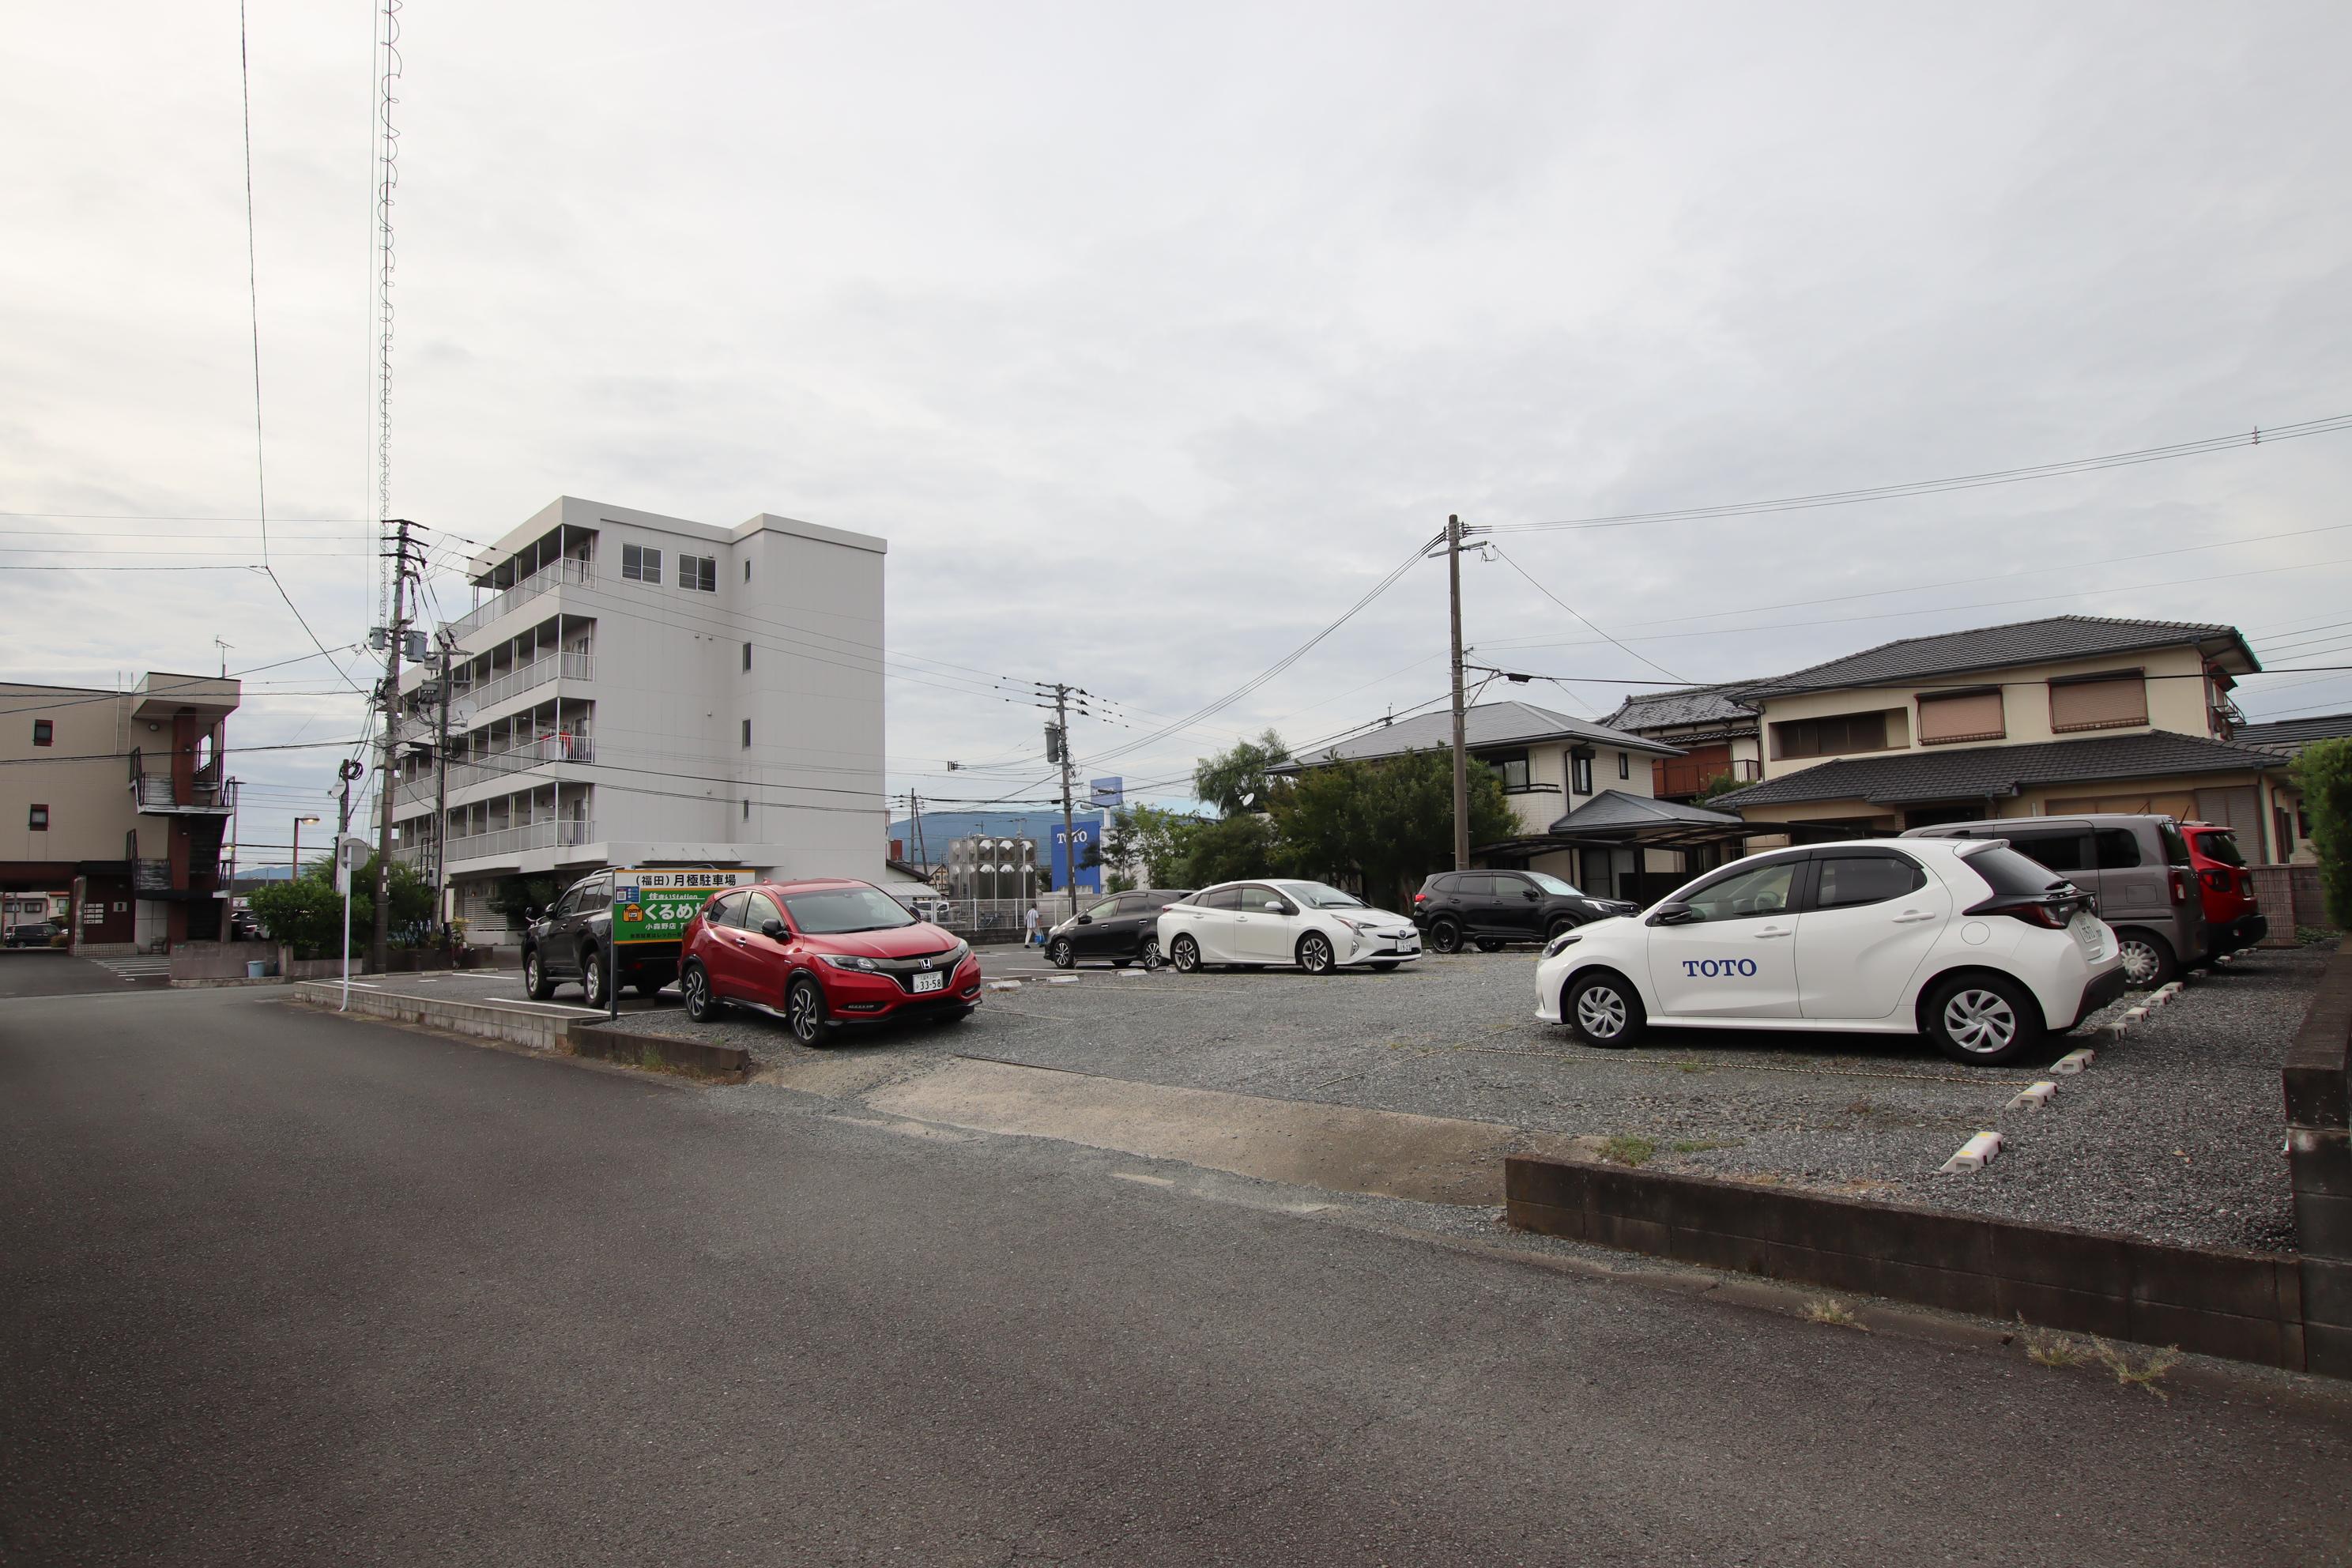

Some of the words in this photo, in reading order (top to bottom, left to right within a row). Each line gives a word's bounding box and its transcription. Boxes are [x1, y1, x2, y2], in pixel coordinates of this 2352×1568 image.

[1057, 831, 1087, 844] TTO
[1682, 958, 1758, 978] TOTO
[920, 978, 941, 990] 33-58
